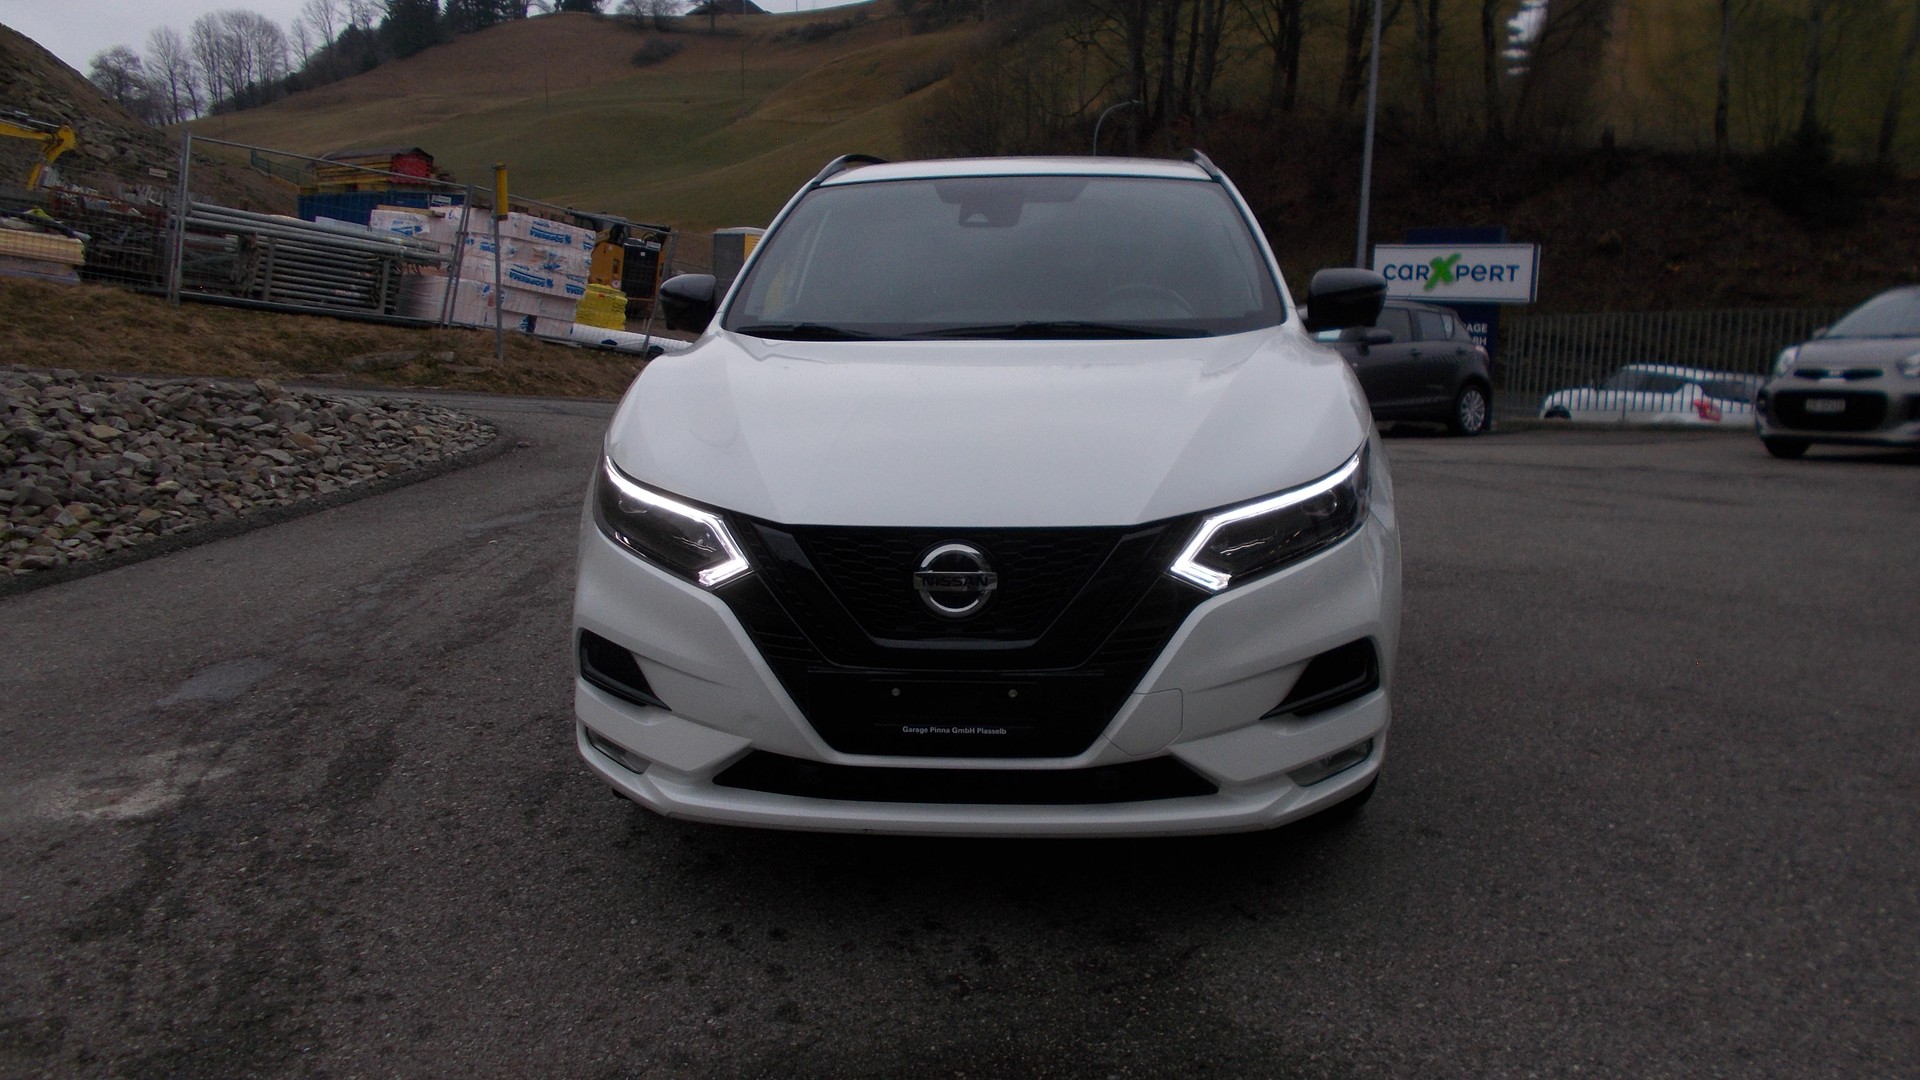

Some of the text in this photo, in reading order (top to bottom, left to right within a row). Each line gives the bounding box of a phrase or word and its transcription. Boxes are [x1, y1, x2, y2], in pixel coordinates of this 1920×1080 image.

[922, 575, 988, 586] NISSAN
[902, 725, 1007, 735] Garage Pinna GmbH Plasselb
